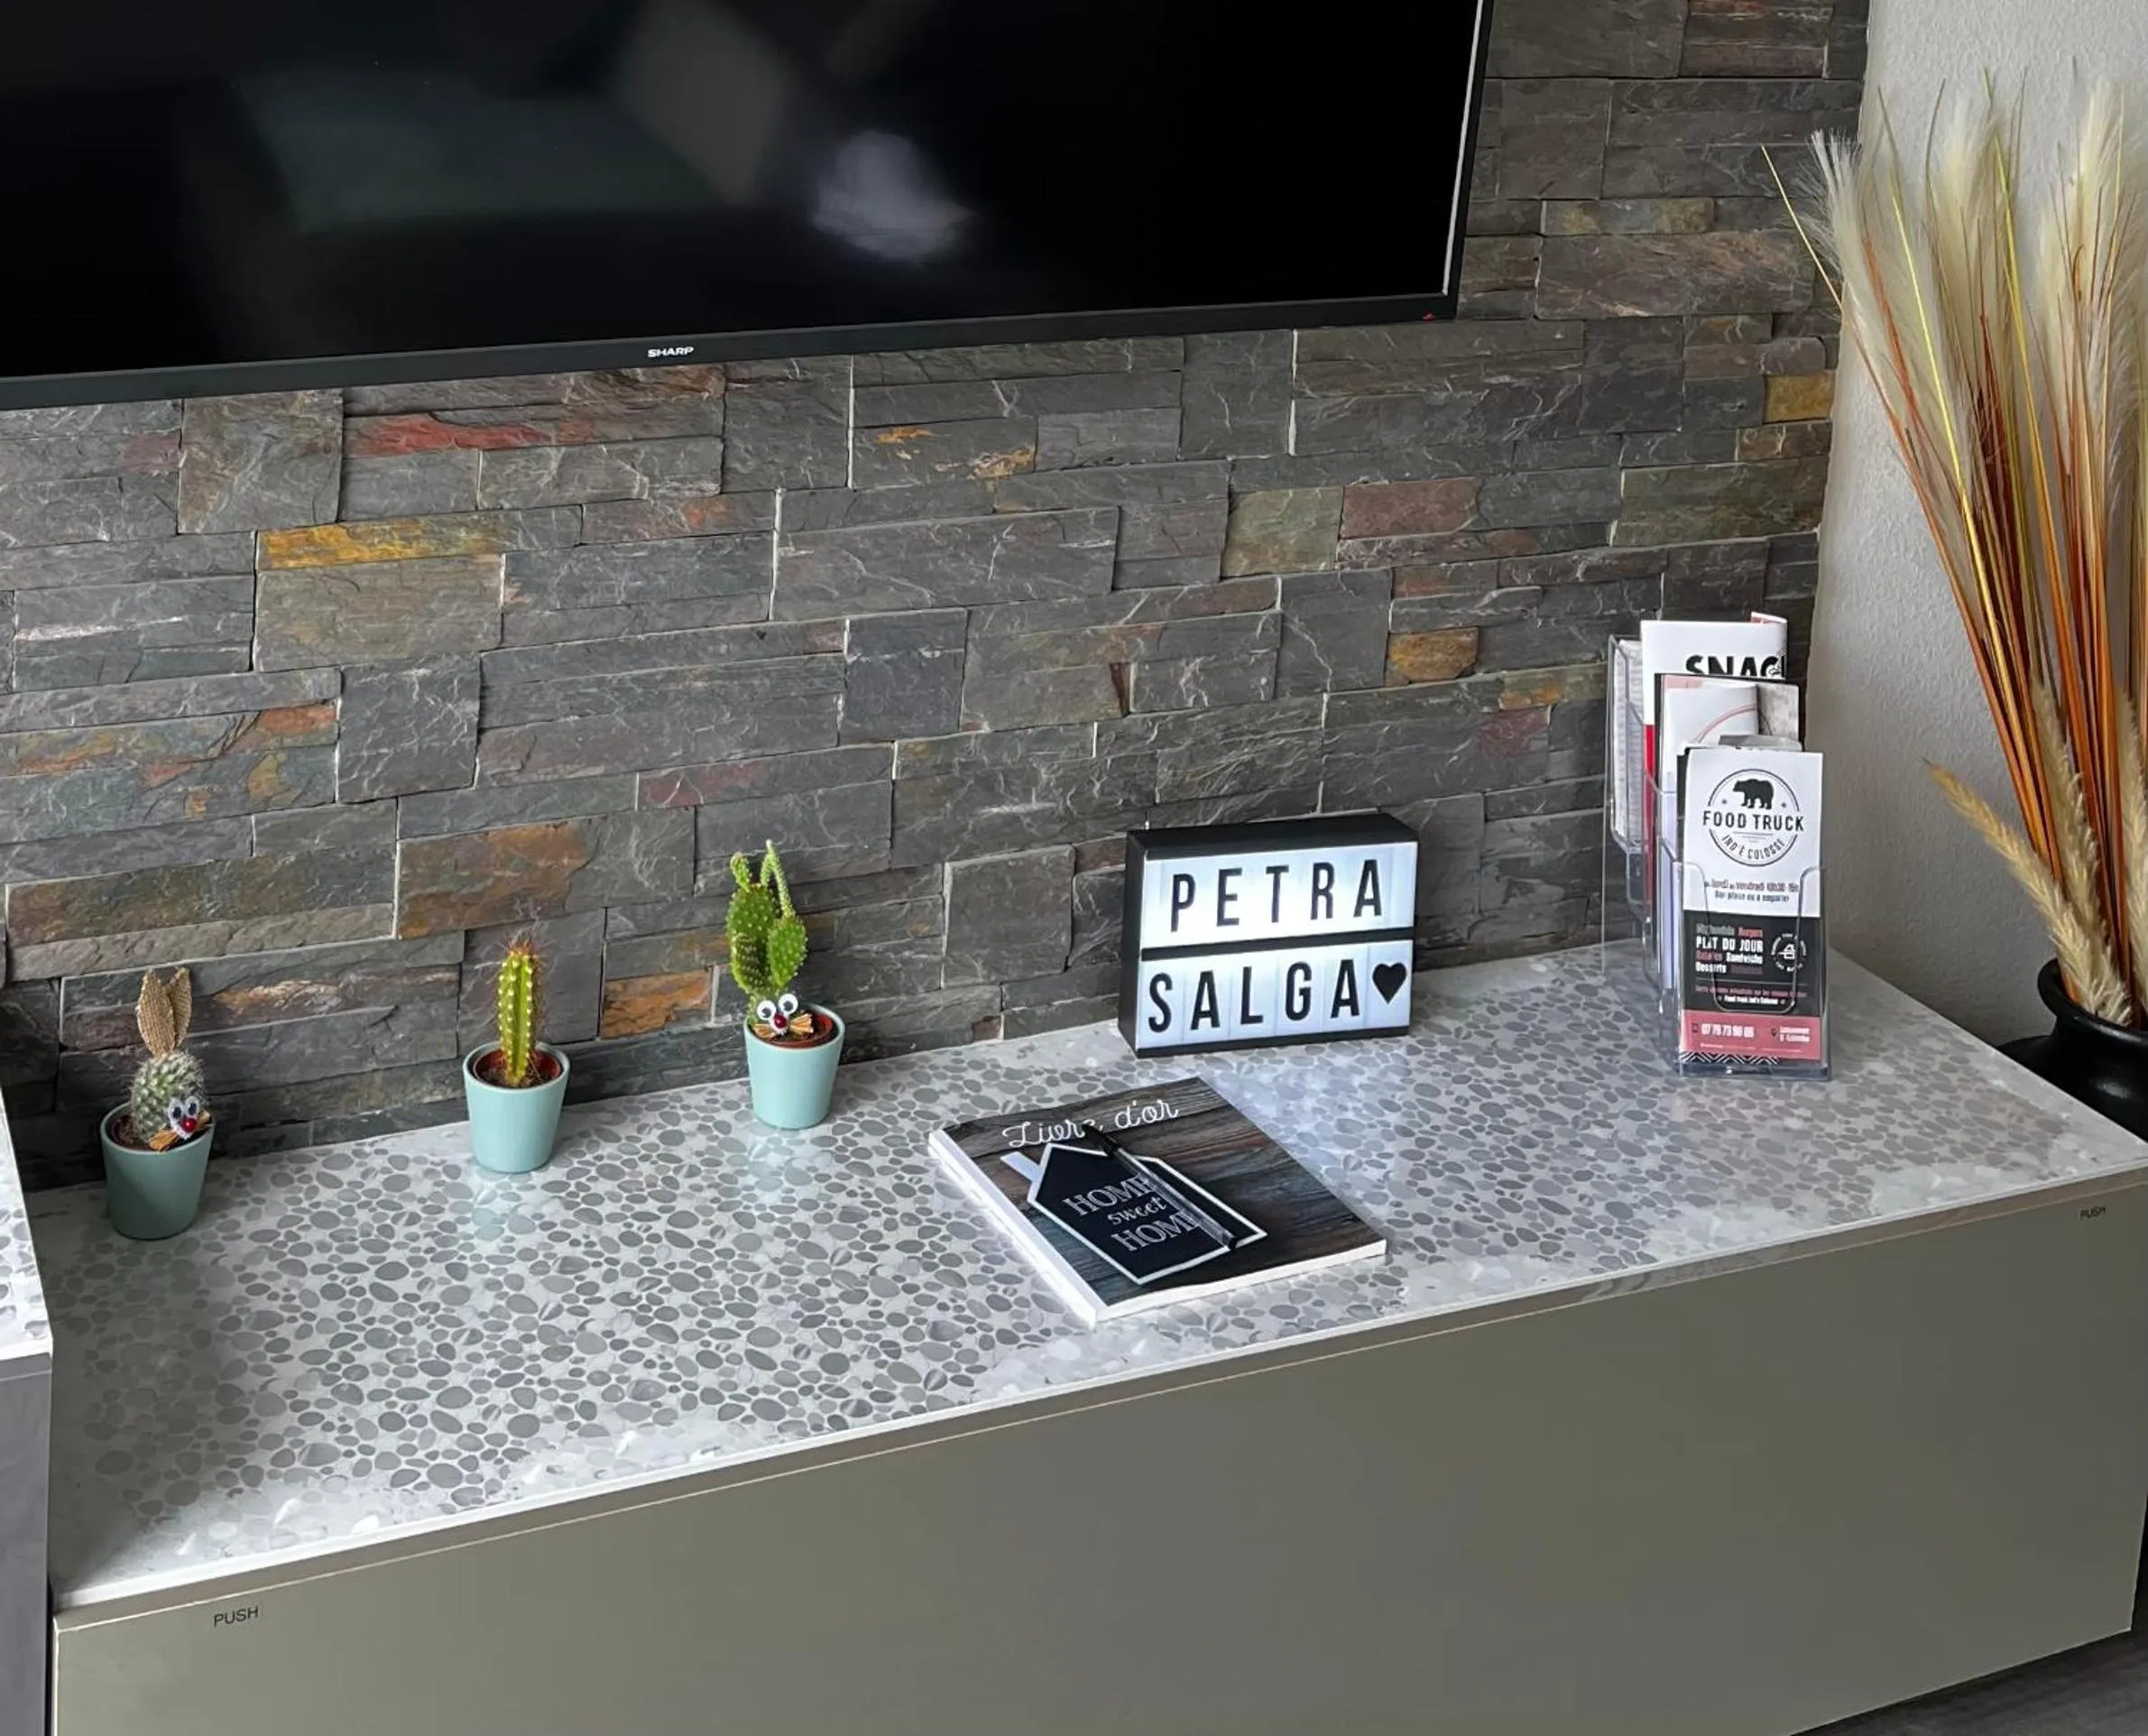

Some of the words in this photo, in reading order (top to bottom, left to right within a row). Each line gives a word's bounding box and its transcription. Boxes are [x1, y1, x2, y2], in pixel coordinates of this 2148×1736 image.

[648, 346, 694, 357] SHARP
[1685, 654, 1785, 678] SNAC
[1703, 810, 1747, 828] FOOD
[1753, 814, 1804, 831] TRUCK
[1171, 859, 1382, 932] PETRA
[1696, 936, 1719, 950] PLAT
[1721, 937, 1736, 951] DU
[1739, 939, 1764, 953] JOUR
[1148, 959, 1360, 1033] SALGA
[1107, 1196, 1167, 1225] sweet
[214, 1605, 258, 1628] PUSH
